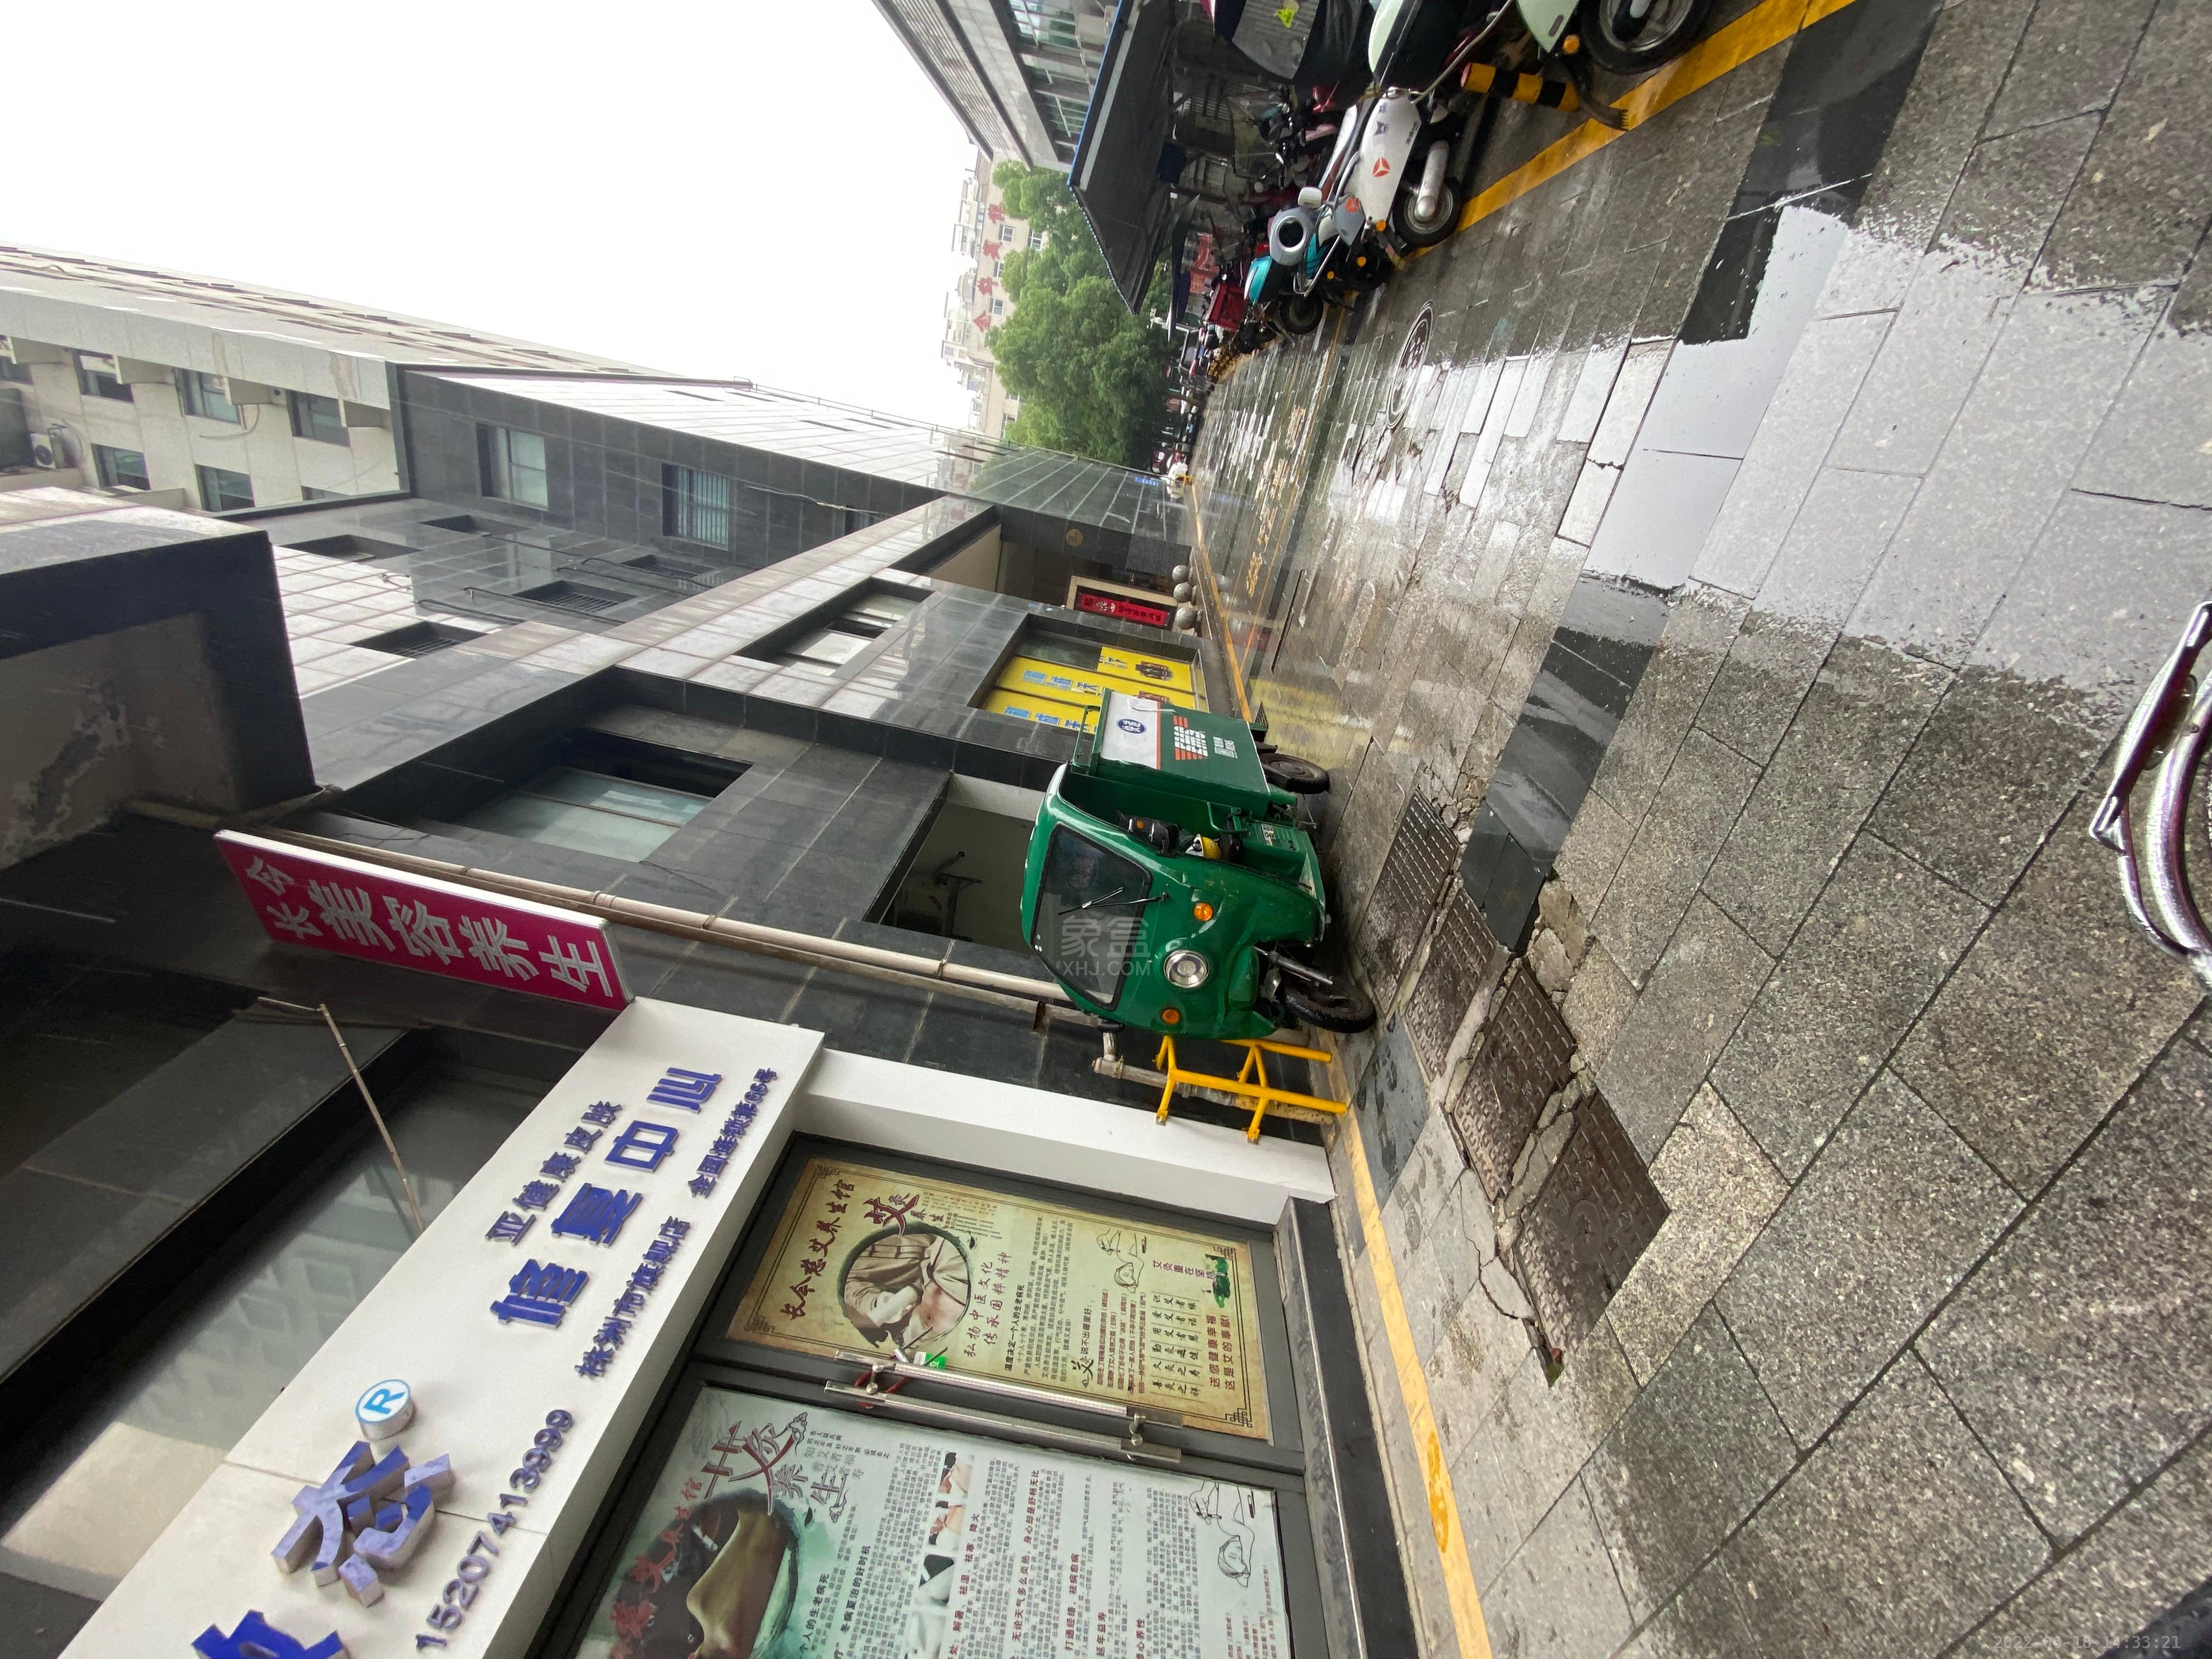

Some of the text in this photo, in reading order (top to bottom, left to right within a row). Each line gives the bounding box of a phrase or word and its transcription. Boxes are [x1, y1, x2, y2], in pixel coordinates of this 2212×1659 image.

[246, 855, 325, 939] 长今
[308, 882, 613, 999] 美容养生
[484, 1100, 621, 1246] 亚健康皮肤
[490, 1068, 723, 1328] 修复中心
[781, 1179, 853, 1319] 长今慈艾养生馆
[1152, 1260, 1215, 1279] 艾灸重在坚持
[963, 1261, 993, 1357] 弘扬中医文化
[982, 1251, 1012, 1346] 传承国粹精神
[1003, 1284, 1025, 1371] 温度决定一个人的生老病死
[1152, 1309, 1198, 1327] 爱艾者福
[415, 1066, 778, 1650] 15207413999 株洲市旗舰店 全国连锁第66号
[1152, 1359, 1200, 1379] 久灸之寿
[1206, 1314, 1220, 1388] 送您健康幸福
[1095, 1611, 1107, 1657] 延年益寿
